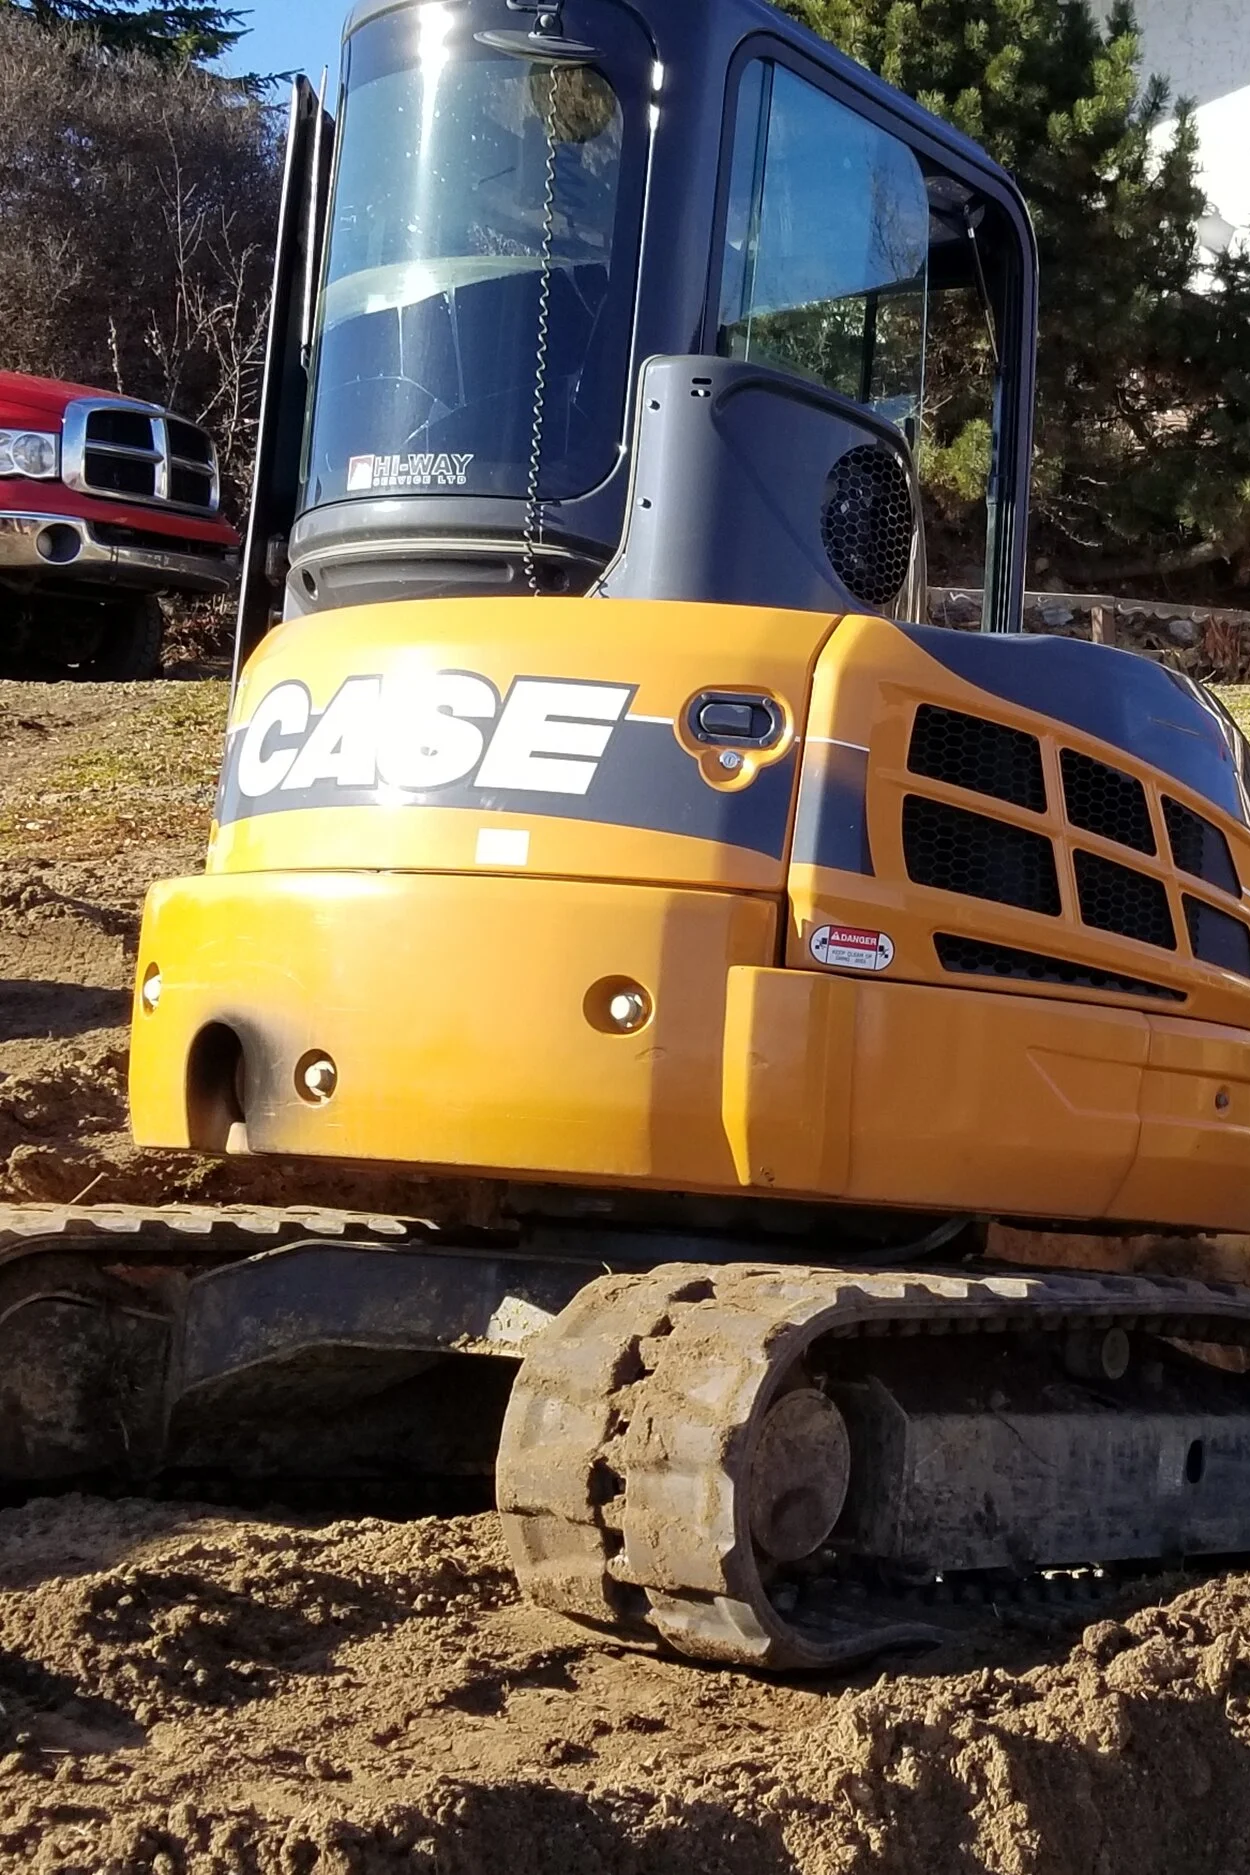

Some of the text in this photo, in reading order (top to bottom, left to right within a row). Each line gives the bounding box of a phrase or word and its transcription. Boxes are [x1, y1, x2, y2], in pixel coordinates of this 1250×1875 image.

[374, 454, 474, 476] HI-WAY
[373, 475, 467, 486] SERVICE LTD
[236, 670, 637, 798] CASE
[841, 934, 877, 945] DANGER
